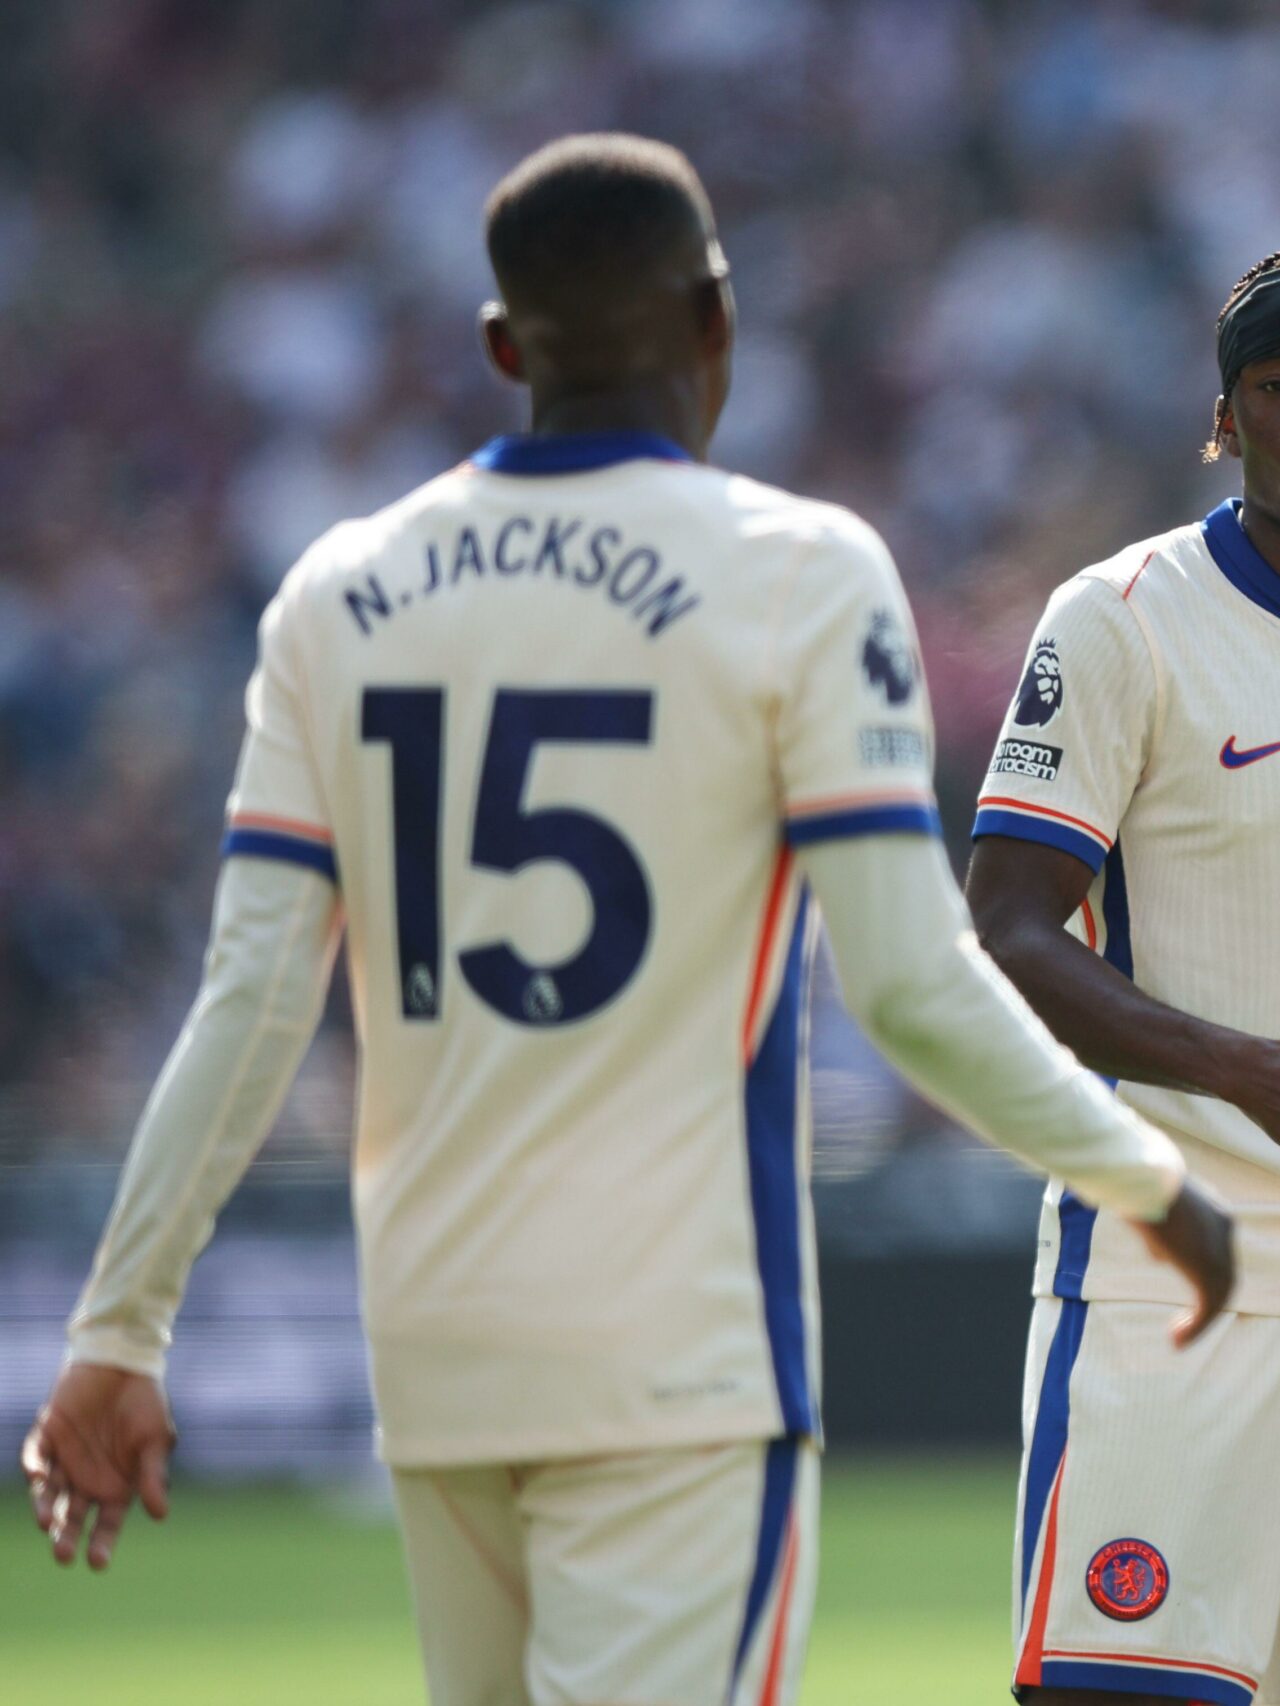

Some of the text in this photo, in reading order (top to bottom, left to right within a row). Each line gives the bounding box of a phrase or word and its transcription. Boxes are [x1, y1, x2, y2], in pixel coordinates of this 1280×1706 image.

[1004, 742, 1053, 765] room
[1000, 758, 1057, 780] racism
[360, 687, 655, 1027] 15
